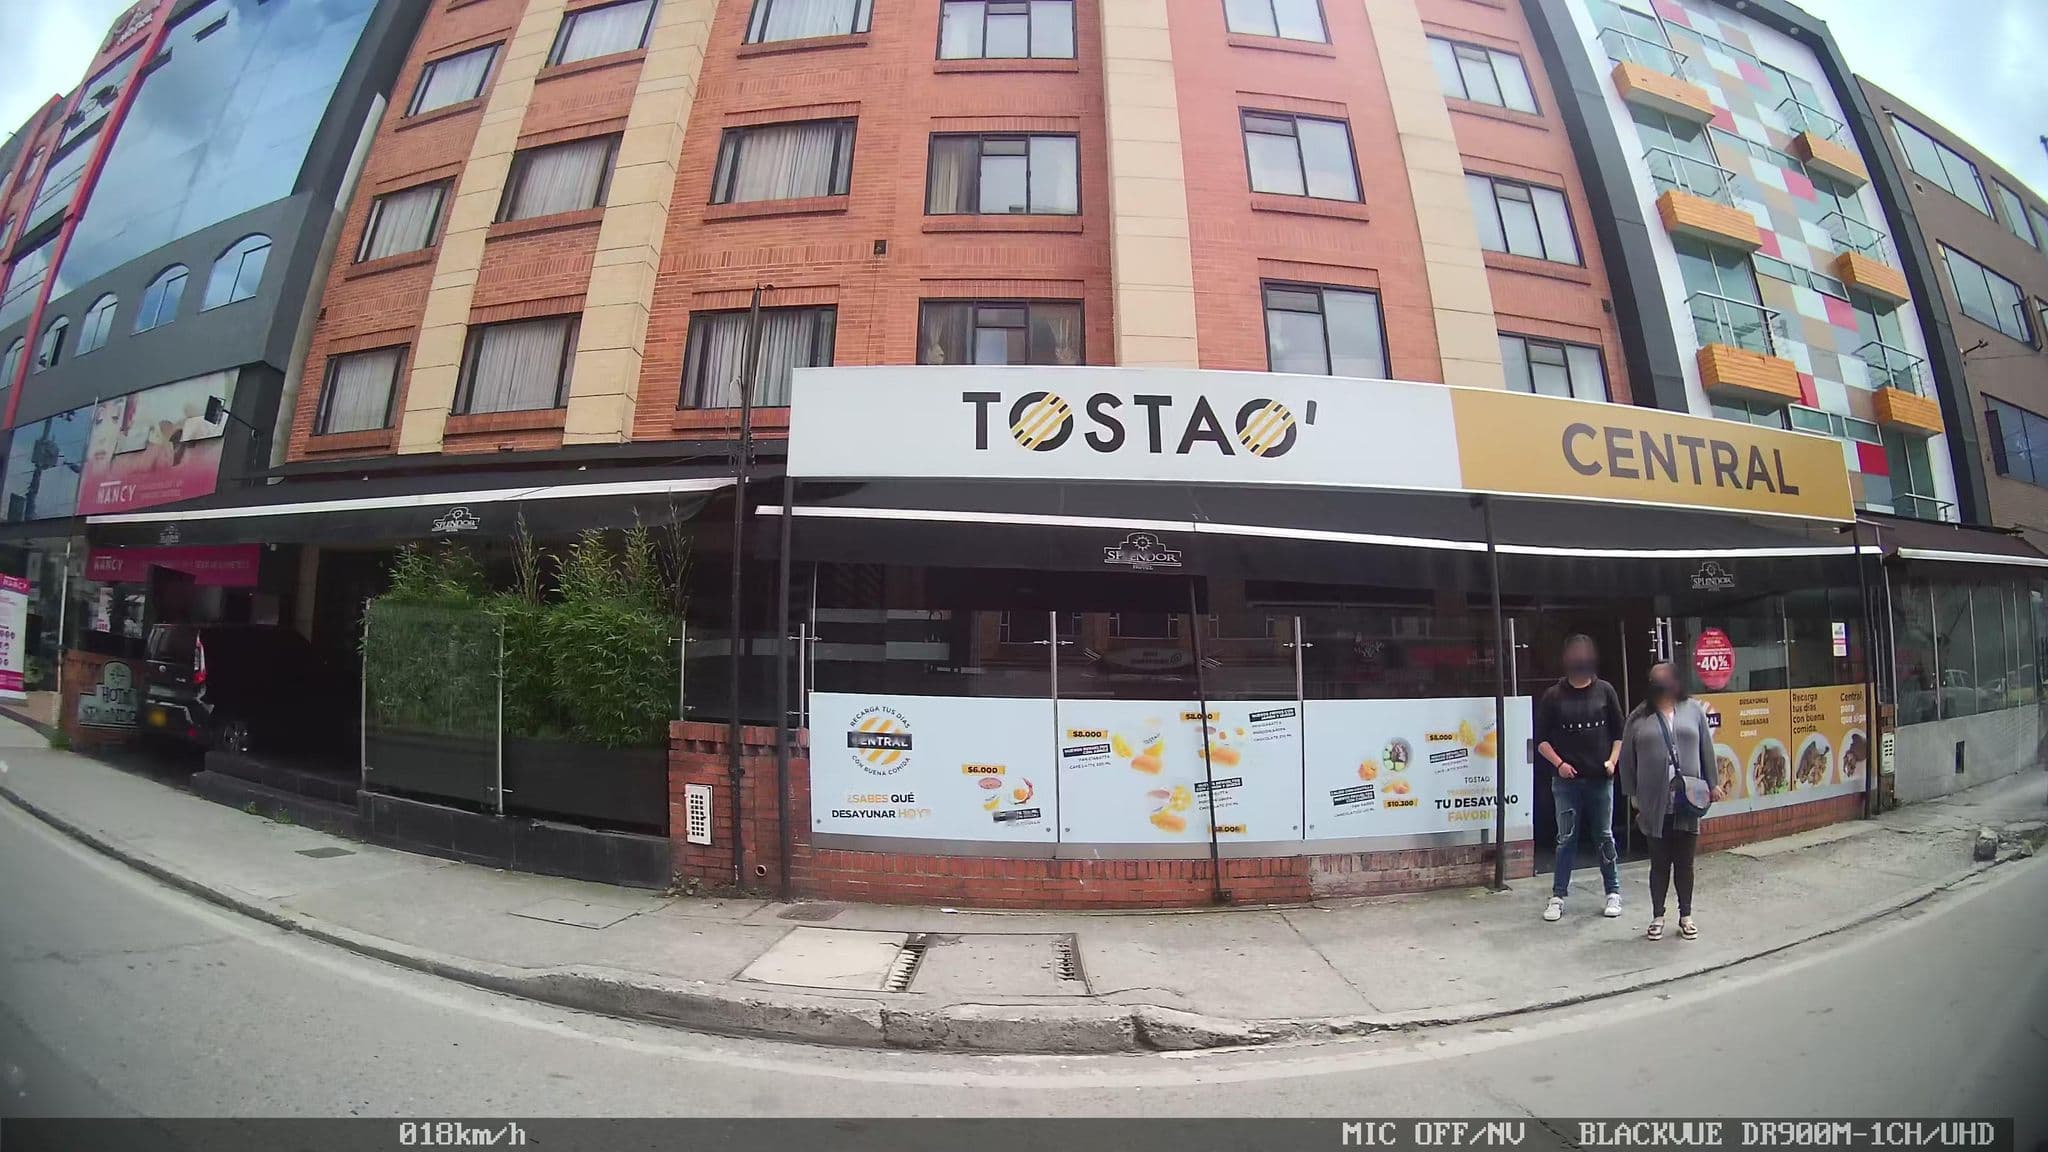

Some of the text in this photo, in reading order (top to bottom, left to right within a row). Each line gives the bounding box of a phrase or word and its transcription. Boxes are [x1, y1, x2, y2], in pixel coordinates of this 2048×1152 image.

[962, 390, 1318, 458] TOSTAO'
[1561, 422, 1800, 496] CENTRAL
[1107, 550, 1178, 562] SPENDOR
[1697, 655, 1729, 671] -40%
[1792, 693, 1818, 703] Recarga
[1792, 704, 1803, 713] tus
[849, 706, 881, 727] RECARGA
[882, 706, 897, 715] TUS
[1793, 713, 1825, 724] con buena
[864, 766, 887, 776] BUENA
[890, 791, 915, 803] QUÉ
[1434, 794, 1519, 810] TU DESAYUNO
[831, 809, 896, 819] DESAYUNAR
